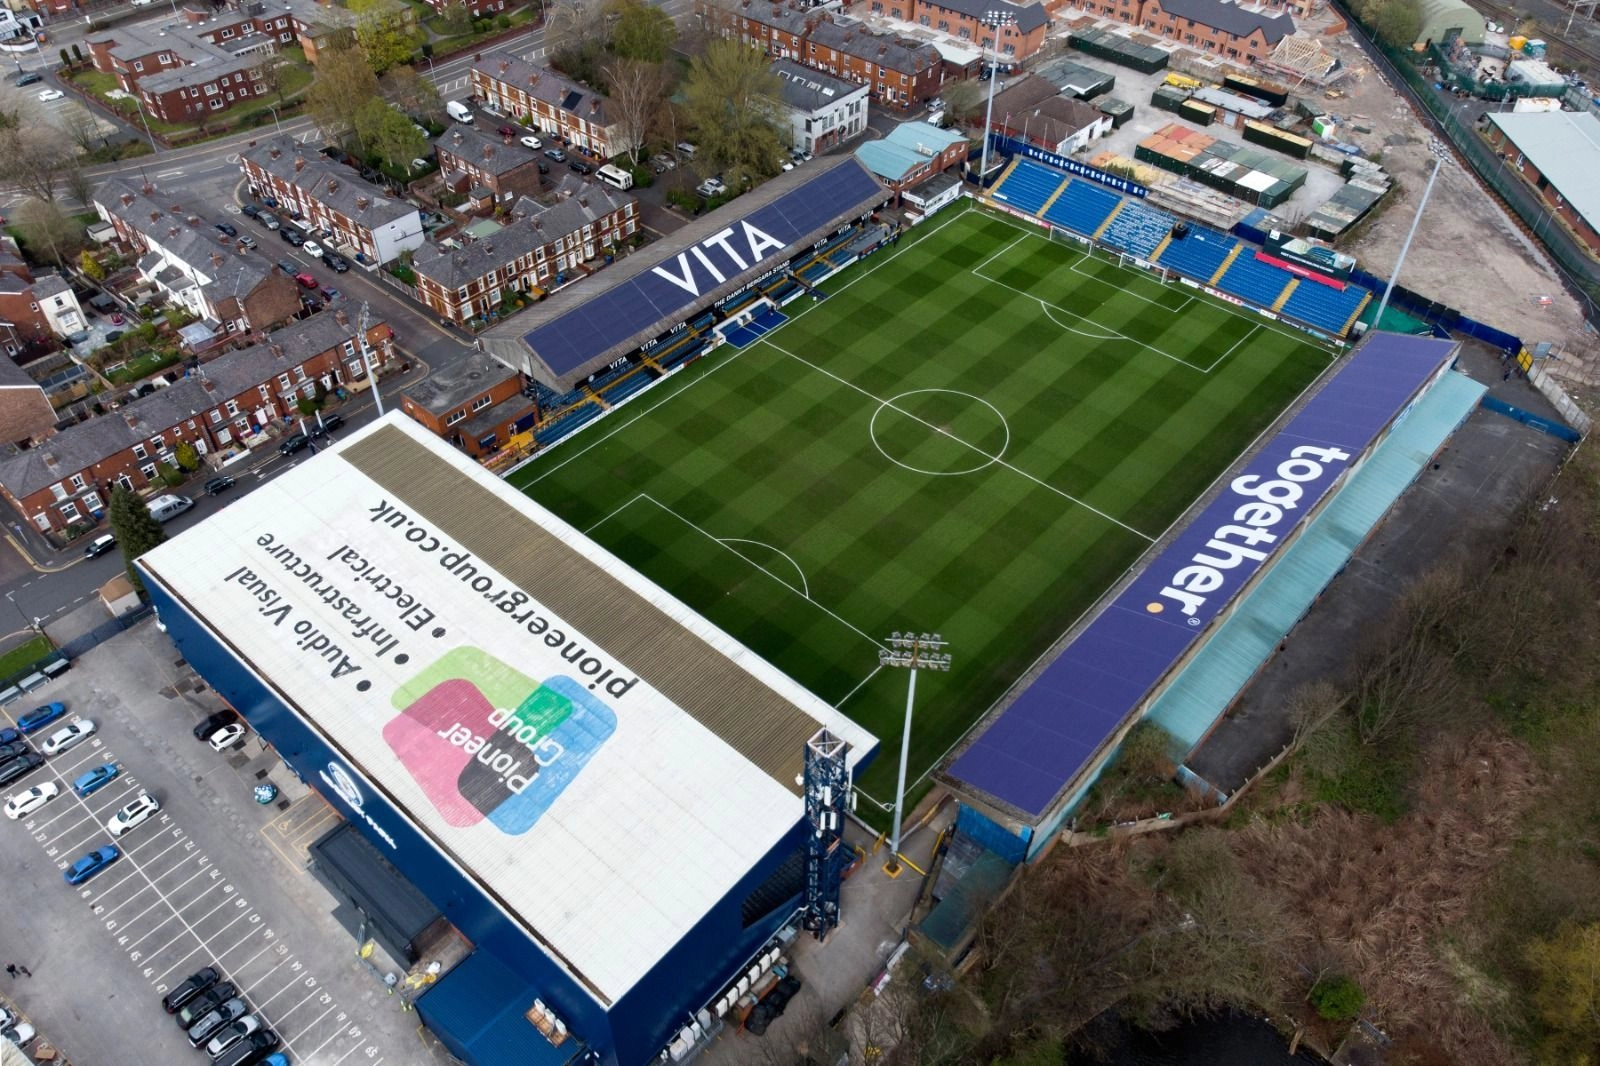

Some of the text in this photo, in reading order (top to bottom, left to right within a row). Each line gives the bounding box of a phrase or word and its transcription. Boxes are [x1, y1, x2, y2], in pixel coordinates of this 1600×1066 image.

[838, 224, 851, 235] VITA
[814, 237, 828, 249] VITA
[651, 220, 786, 297] VITA
[714, 298, 726, 308] THE
[726, 286, 746, 302] DANNY
[772, 260, 790, 273] STAND
[670, 321, 688, 334] VITA
[640, 338, 658, 352] VITA
[609, 356, 628, 370] VITA
[256, 531, 399, 658] Infrastructure
[326, 545, 438, 632] Electrical
[368, 499, 640, 699] pioneergroup.co.uk
[224, 566, 362, 681] Audio Visual
[486, 706, 565, 769] Group
[437, 721, 542, 795] Pioneer
[125, 776, 136, 786] 77
[160, 814, 171, 824] 74
[35, 832, 47, 843] 37
[185, 841, 196, 851] 72
[198, 856, 209, 866] 71
[209, 869, 221, 880] 70
[235, 898, 248, 908] 68
[93, 905, 105, 915] 42
[249, 913, 261, 923] 67
[105, 920, 117, 931] 43
[263, 929, 274, 939] 66
[118, 935, 129, 946] 44
[130, 950, 142, 962] 45
[276, 944, 288, 956] 65
[291, 960, 303, 972] 64
[143, 967, 154, 978] 46
[305, 976, 317, 988] 63
[156, 983, 168, 994] 47
[319, 992, 332, 1005] 62
[336, 1011, 347, 1022] 61
[348, 1026, 361, 1038] 60
[365, 1045, 378, 1058] 59
